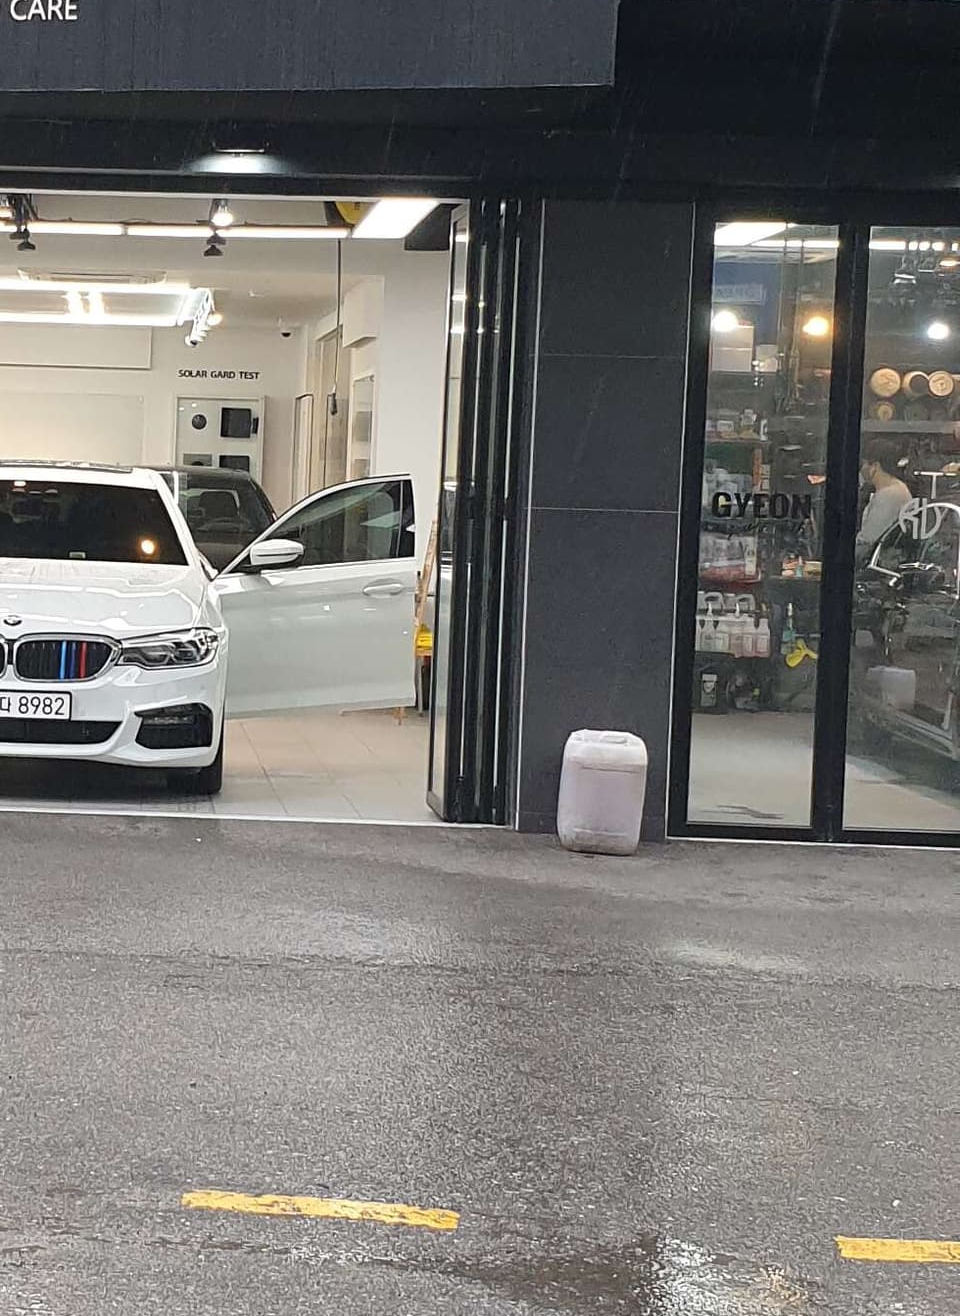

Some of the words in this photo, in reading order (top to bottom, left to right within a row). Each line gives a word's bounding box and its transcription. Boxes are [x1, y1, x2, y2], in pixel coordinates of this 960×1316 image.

[177, 369, 208, 379] SOLAR
[210, 370, 236, 380] GARD
[239, 371, 260, 380] TEST
[711, 491, 812, 520] GYEON
[18, 695, 65, 716] 8982
